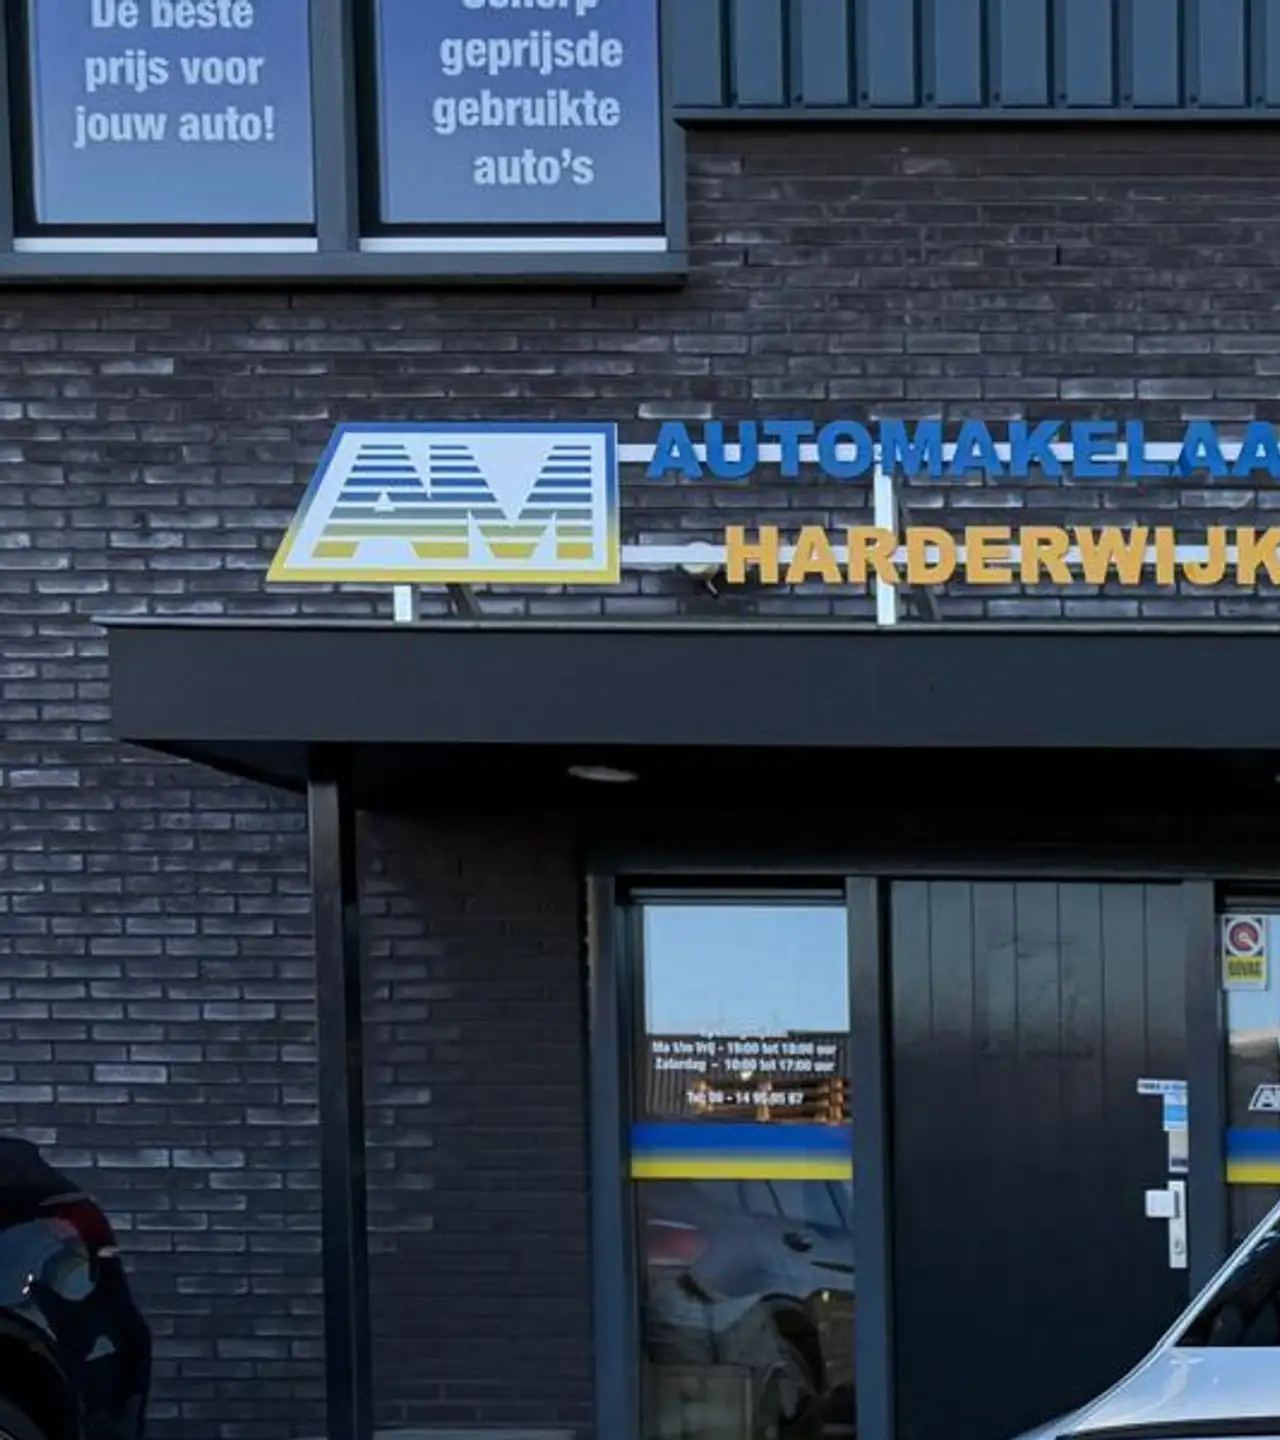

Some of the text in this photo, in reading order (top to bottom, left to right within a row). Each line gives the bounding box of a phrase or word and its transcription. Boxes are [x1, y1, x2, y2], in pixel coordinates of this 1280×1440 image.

[91, 0, 254, 29] De beste
[85, 49, 265, 93] prijs voor
[439, 30, 624, 76] geprijsde
[73, 105, 275, 148] jouw auto!
[432, 89, 621, 135] gebruikte
